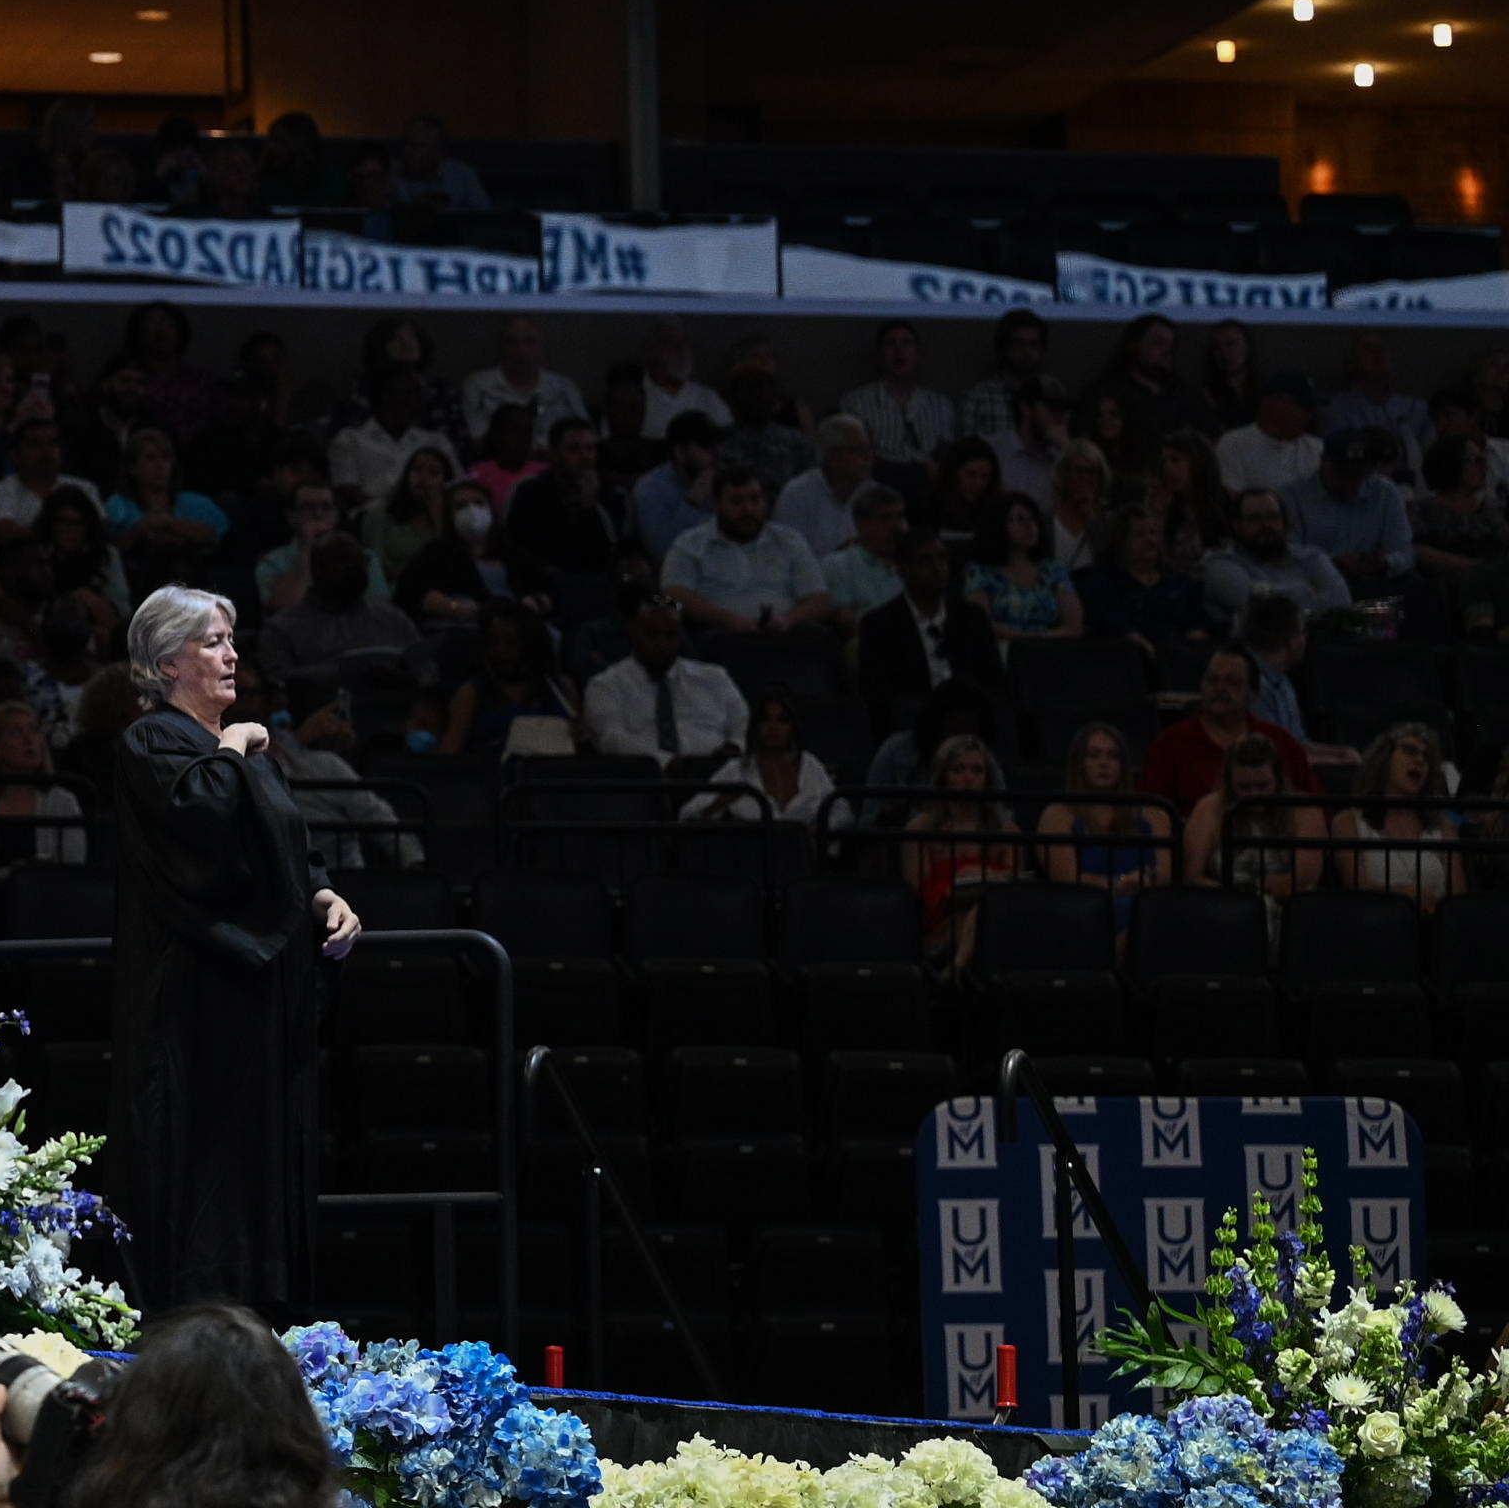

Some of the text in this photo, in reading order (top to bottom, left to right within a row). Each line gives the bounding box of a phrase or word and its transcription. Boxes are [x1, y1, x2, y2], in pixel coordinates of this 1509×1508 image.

[948, 1123, 985, 1160] M
[1152, 1122, 1189, 1159] M
[1358, 1122, 1396, 1159] M
[953, 1206, 987, 1244] U
[1158, 1205, 1192, 1243] U
[1363, 1206, 1398, 1244] U
[953, 1245, 990, 1284] M
[1158, 1245, 1196, 1283] M
[958, 1331, 992, 1370] U
